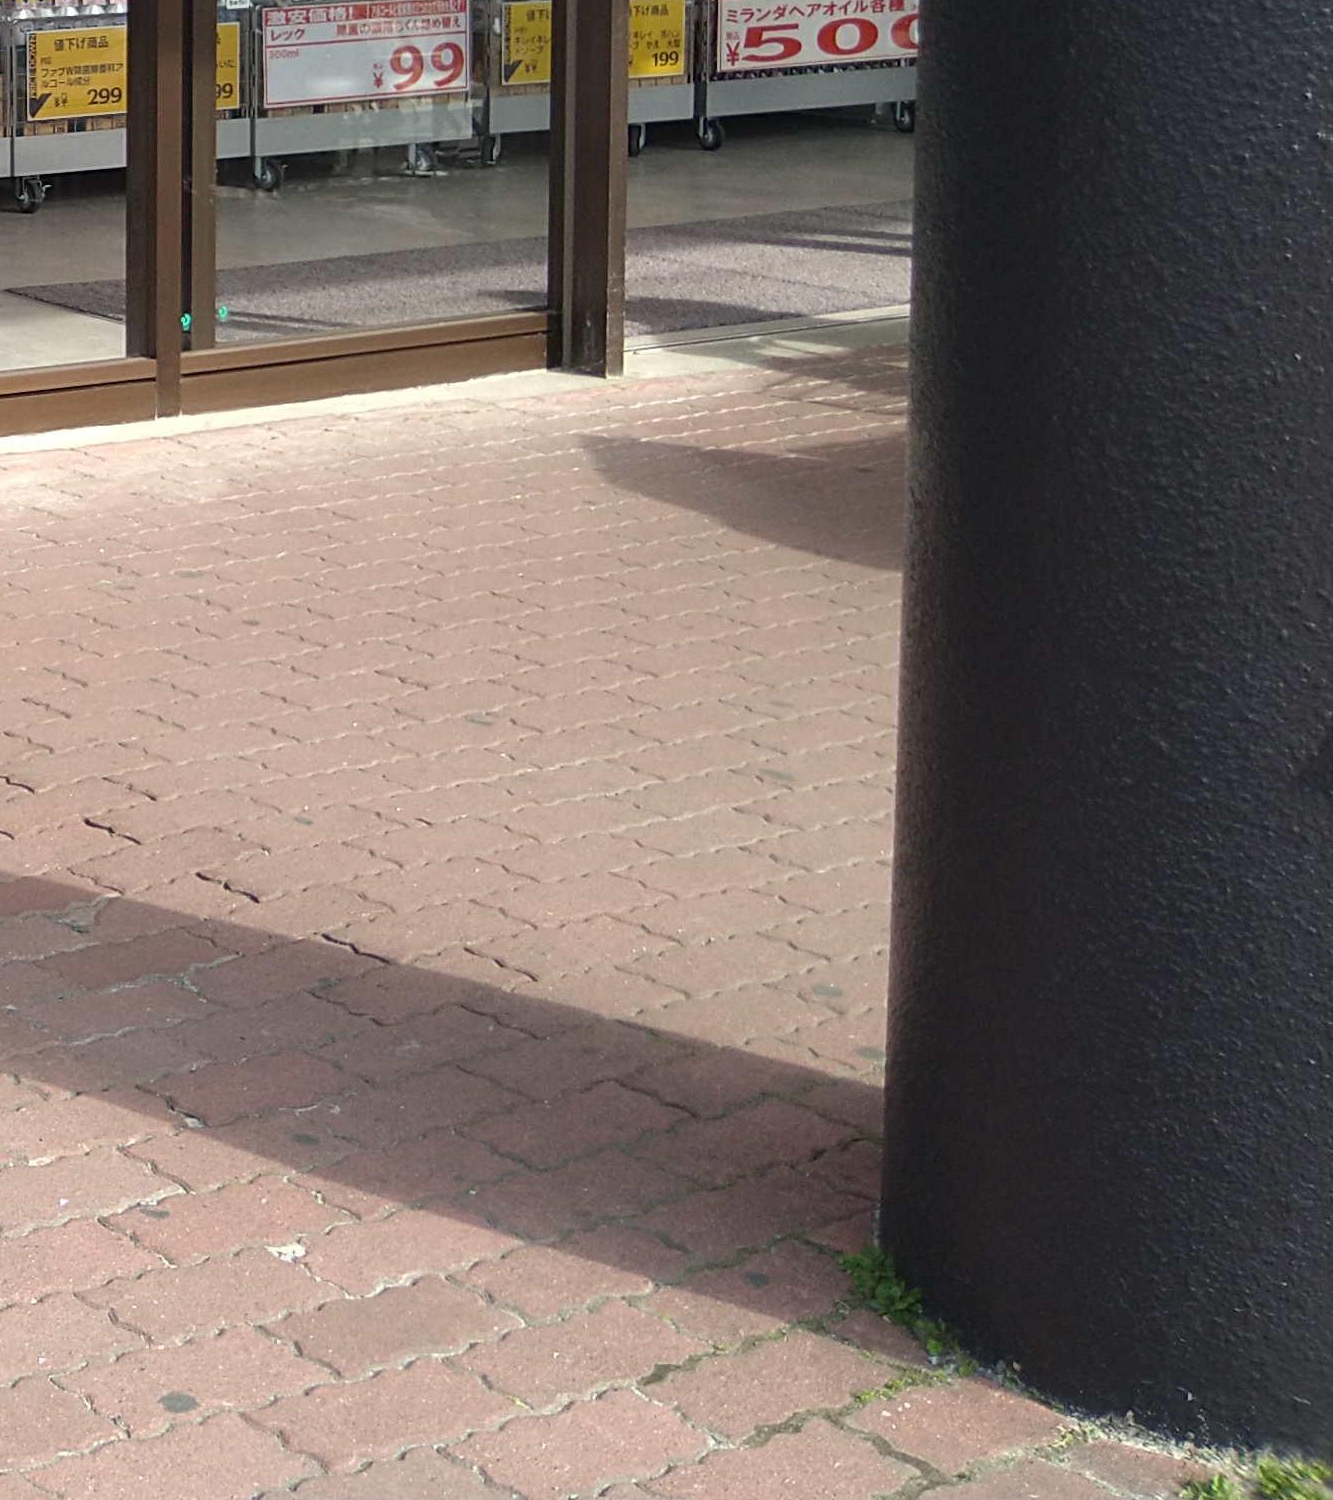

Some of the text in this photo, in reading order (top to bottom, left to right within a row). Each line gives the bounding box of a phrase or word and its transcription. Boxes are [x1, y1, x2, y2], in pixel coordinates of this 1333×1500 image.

[270, 27, 306, 42] レック
[54, 35, 109, 52] 値下げ商品
[652, 51, 680, 67] 199
[87, 86, 123, 106] 299
